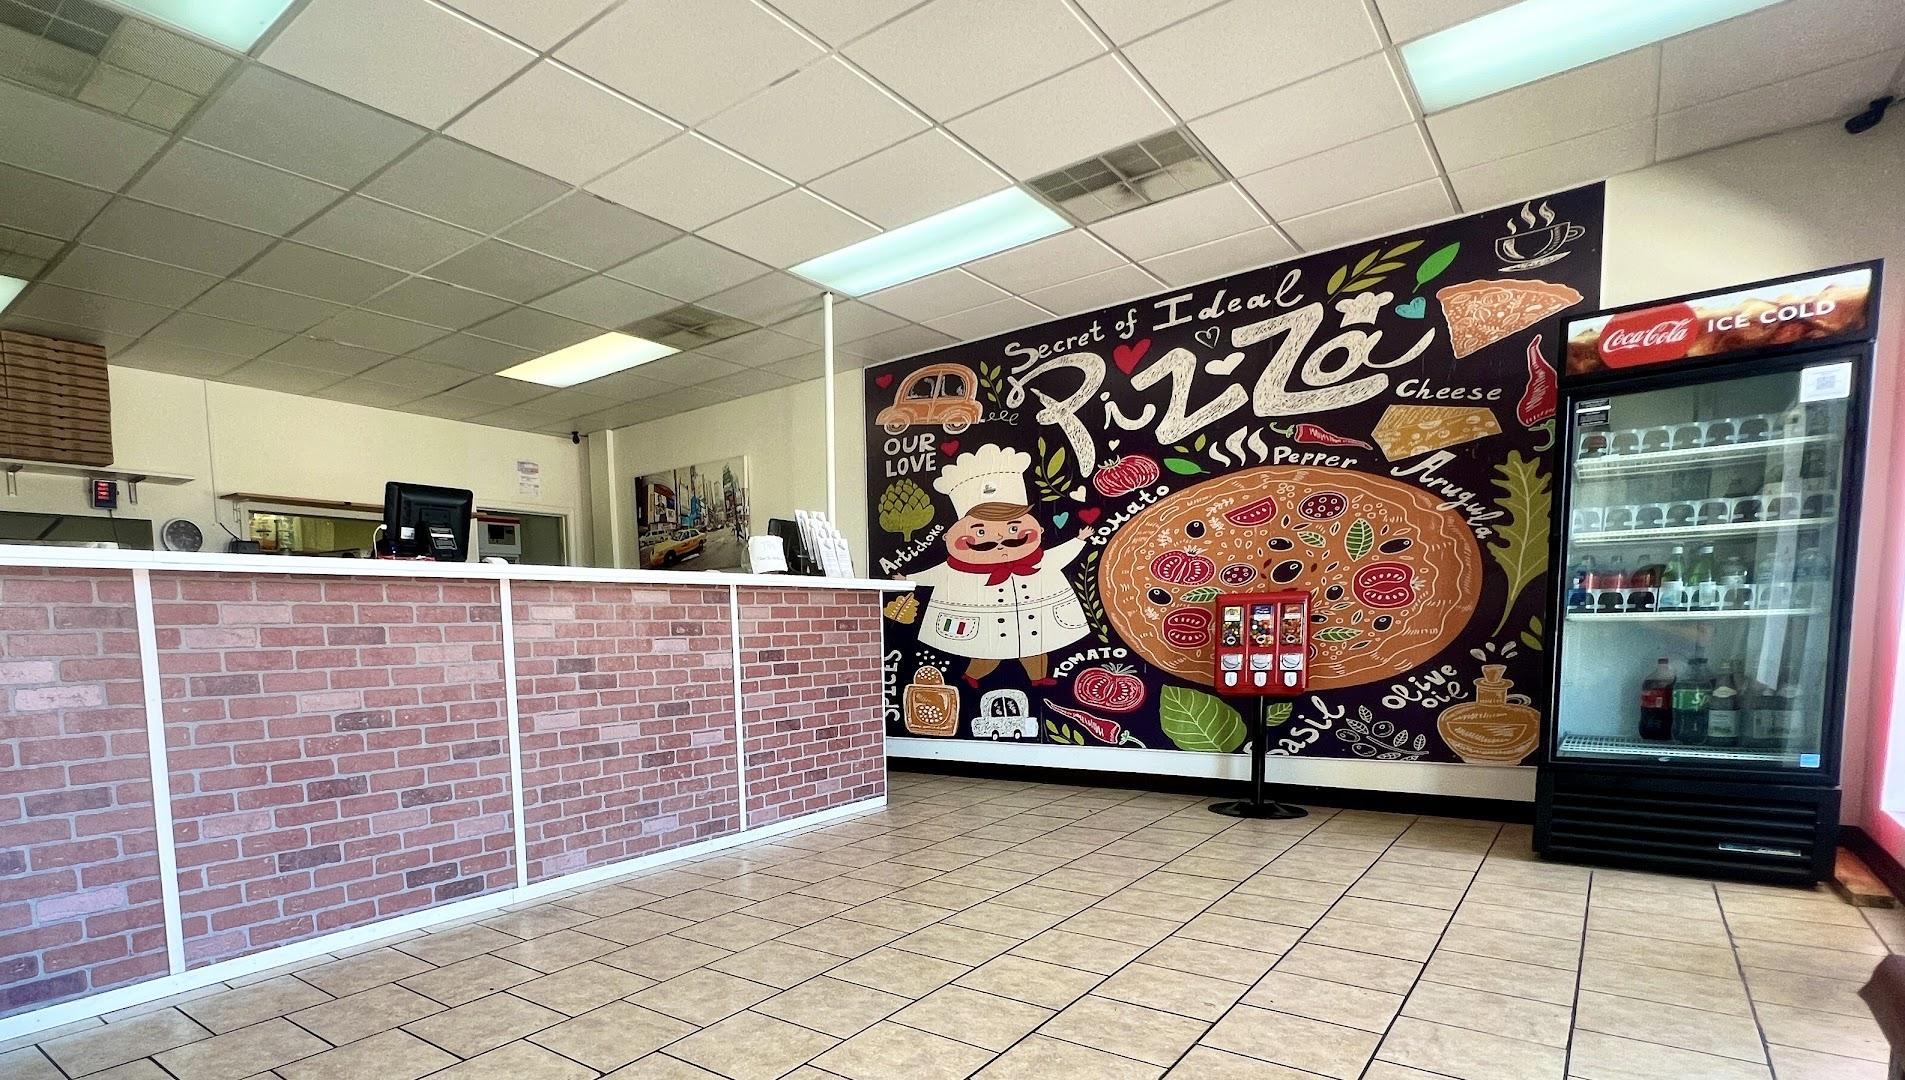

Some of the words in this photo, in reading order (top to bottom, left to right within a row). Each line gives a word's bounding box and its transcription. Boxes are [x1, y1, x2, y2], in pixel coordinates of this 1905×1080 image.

[1004, 323, 1104, 375] Secret
[1115, 309, 1137, 340] of
[1152, 268, 1304, 332] Ideal
[1707, 315, 1751, 334] ICE
[1759, 300, 1836, 326] COLD
[1602, 317, 1695, 353] Coca-Cola
[1396, 378, 1503, 401] Cheese
[883, 433, 937, 456] OUR
[1273, 446, 1358, 469] Pepper
[885, 452, 937, 478] LOVE
[1390, 450, 1504, 540] Arugula
[878, 524, 945, 576] Artichoke
[1053, 647, 1128, 679] TOMATO
